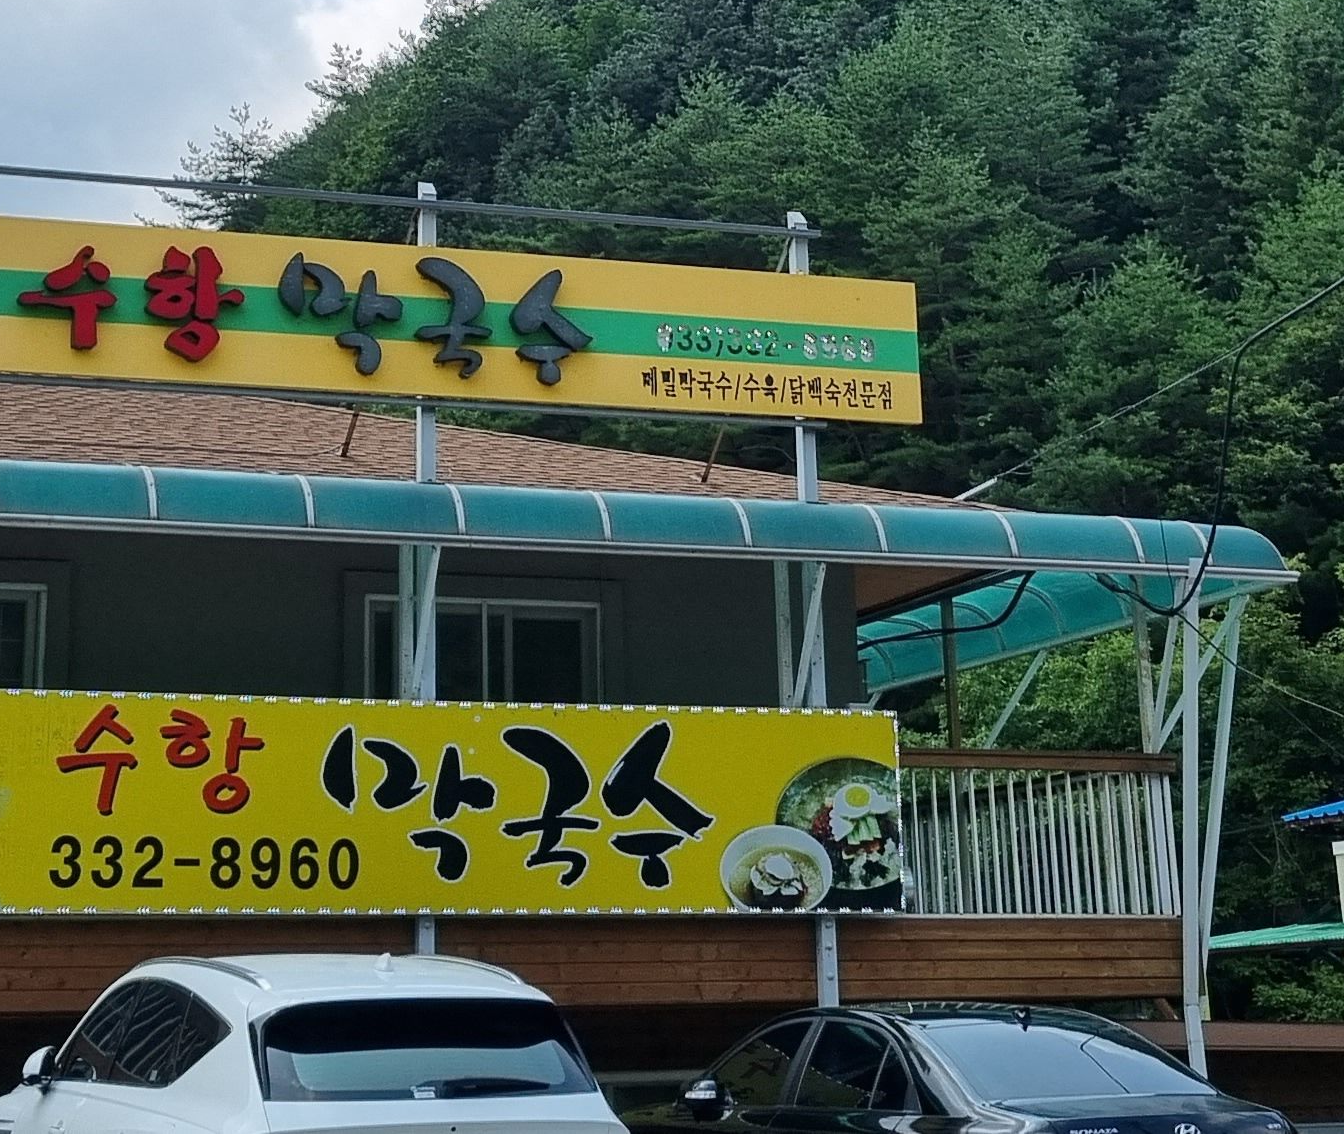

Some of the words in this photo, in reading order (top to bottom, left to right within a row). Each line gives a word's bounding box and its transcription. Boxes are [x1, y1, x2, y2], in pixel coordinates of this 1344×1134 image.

[16, 245, 245, 363] 수항
[277, 251, 592, 387] 막국수
[49, 835, 360, 890] 332-8960
[56, 704, 263, 813] 수항
[320, 721, 715, 888] 막국수
